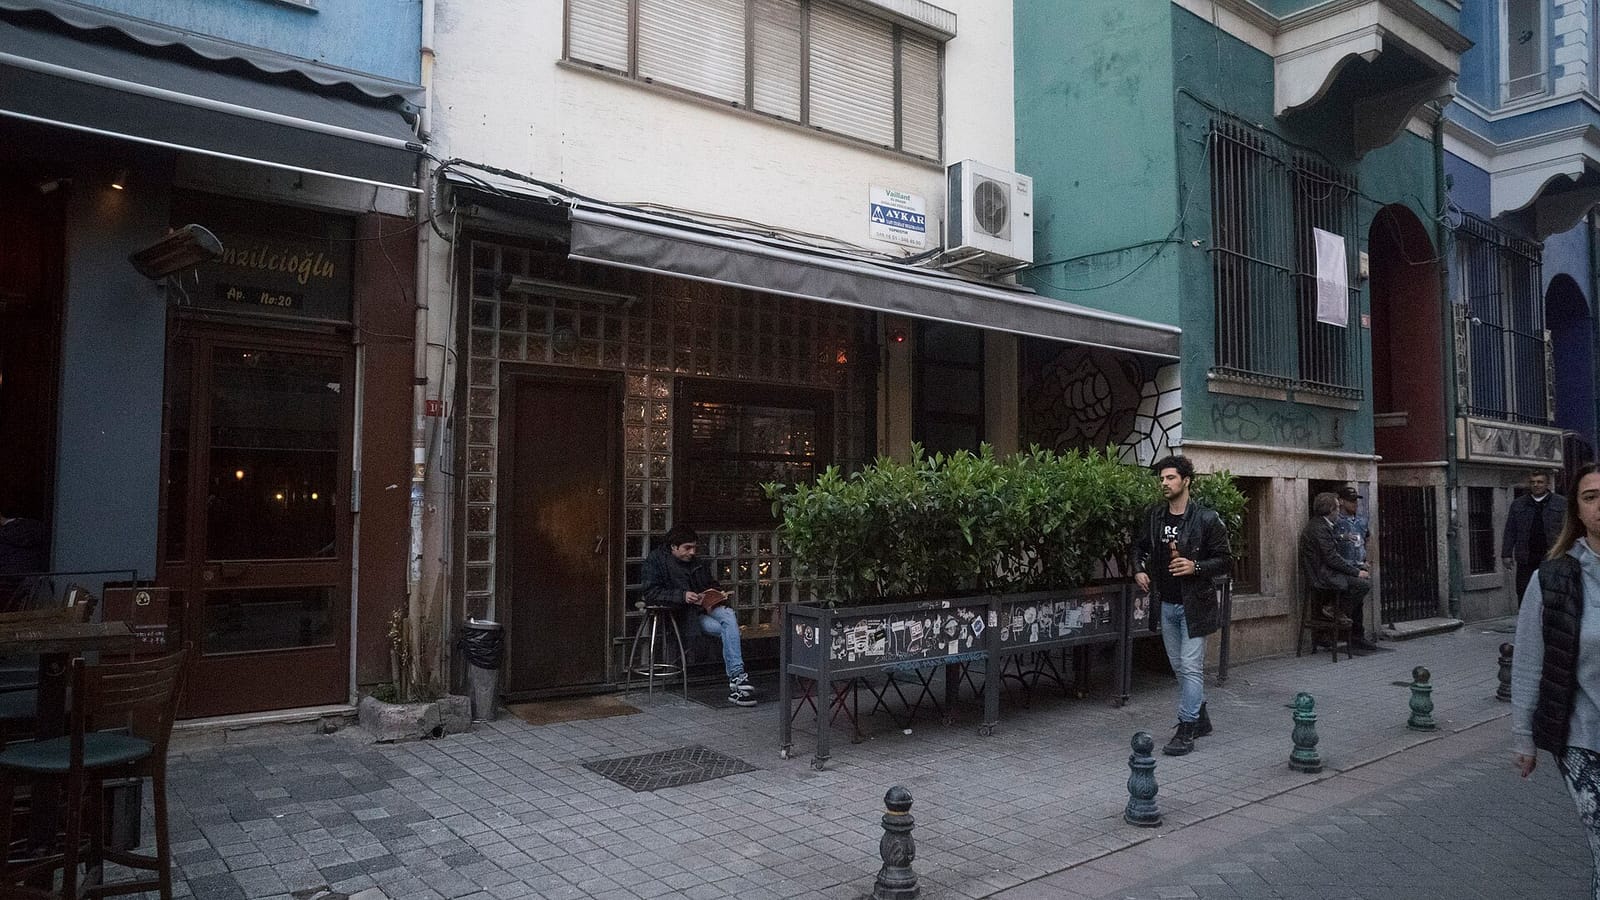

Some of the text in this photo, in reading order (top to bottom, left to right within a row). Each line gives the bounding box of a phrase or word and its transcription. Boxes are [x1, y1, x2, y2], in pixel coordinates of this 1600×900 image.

[886, 209, 925, 225] AYKAR
[226, 287, 292, 307] Ap. No:20
